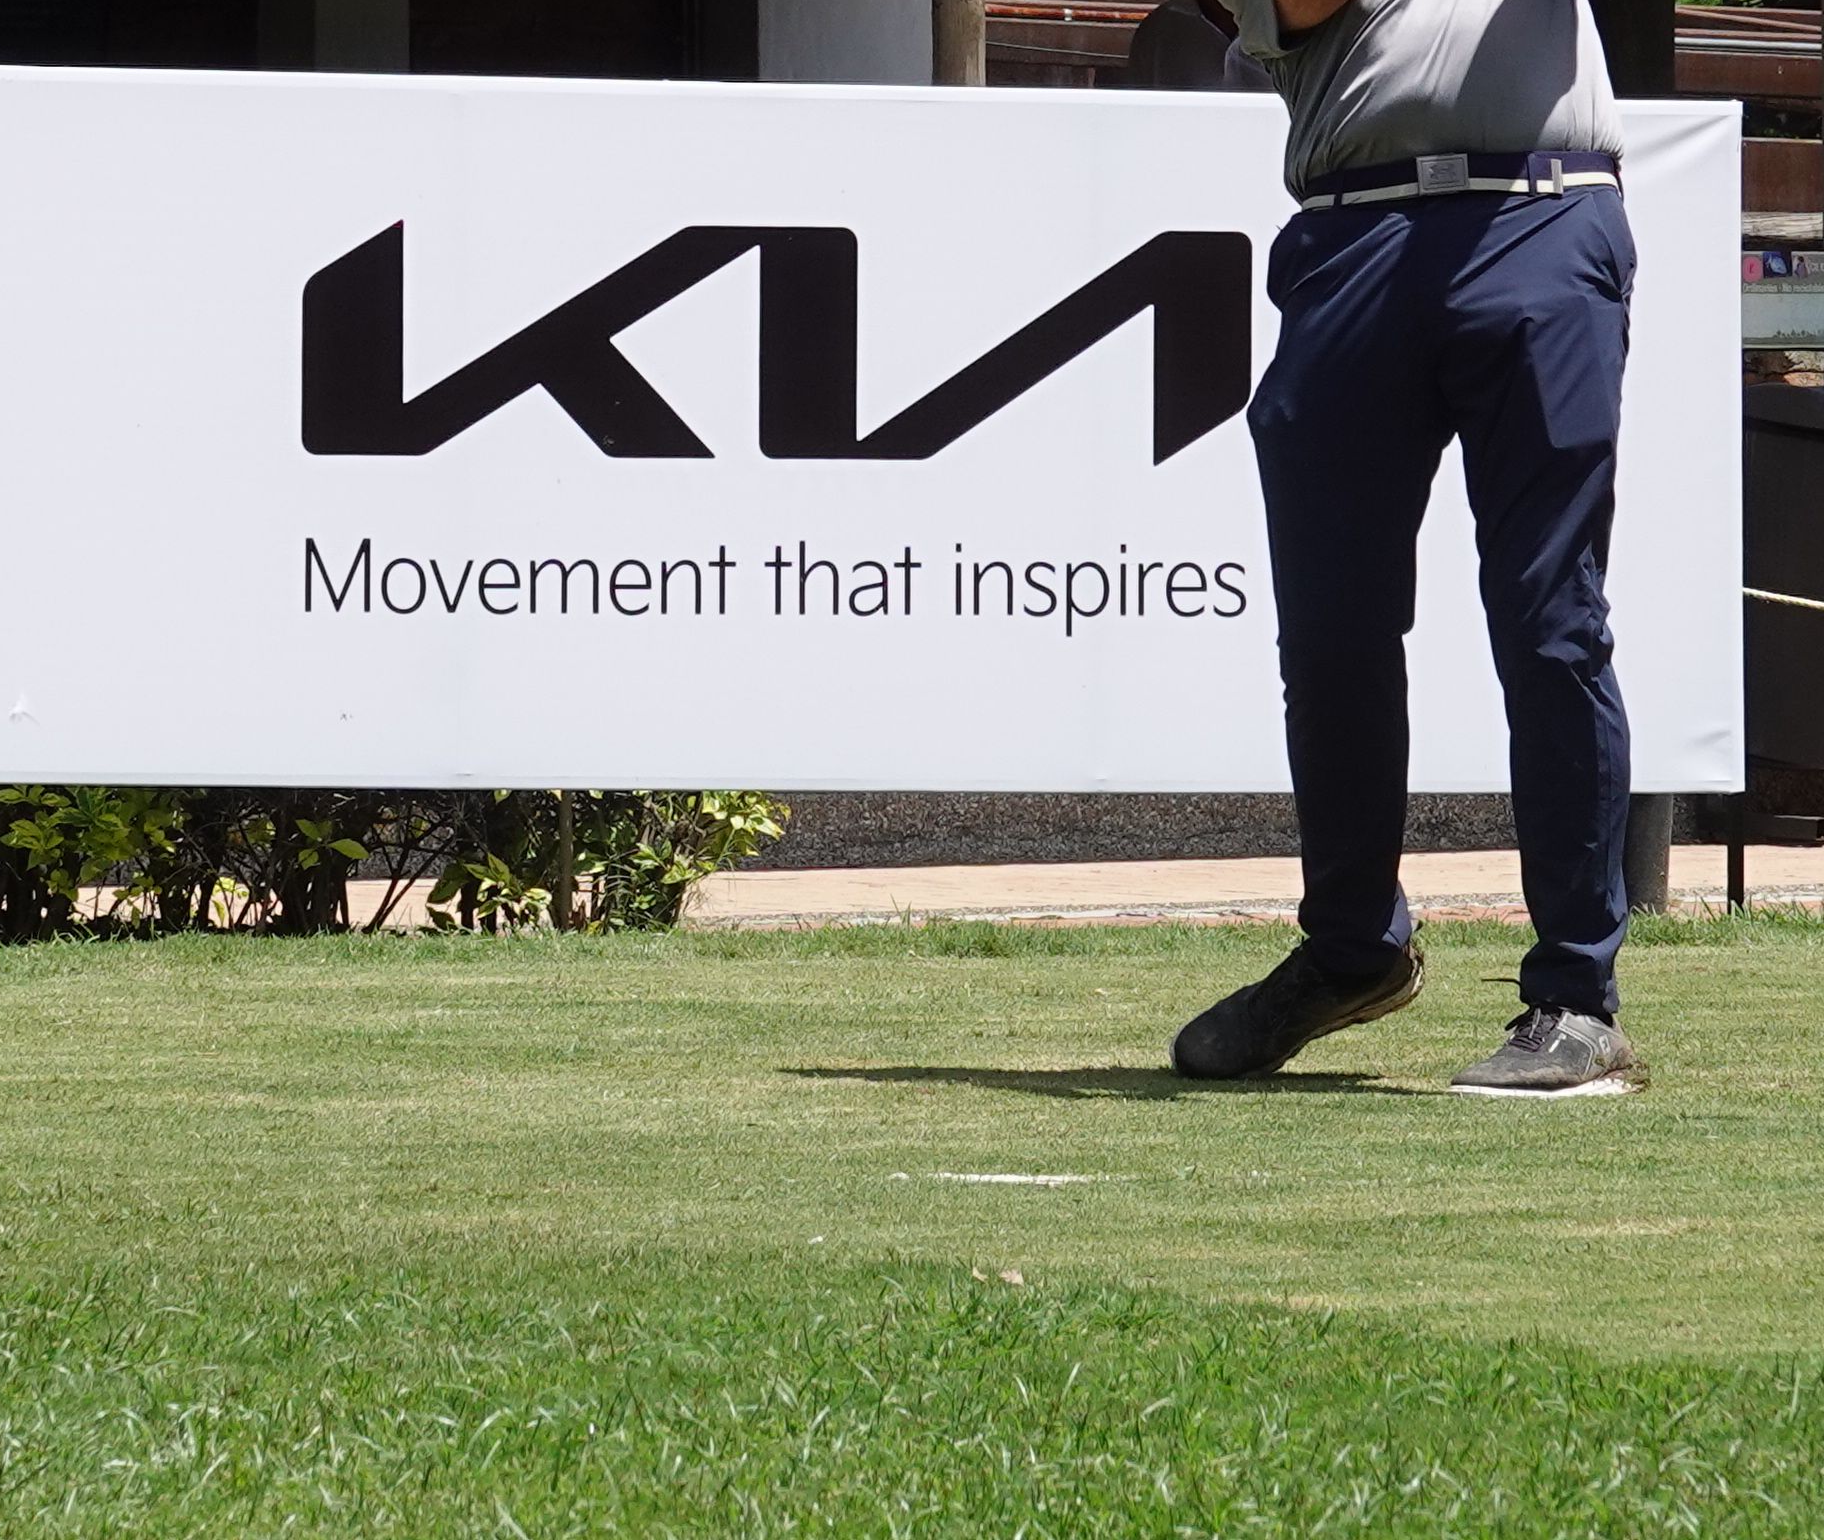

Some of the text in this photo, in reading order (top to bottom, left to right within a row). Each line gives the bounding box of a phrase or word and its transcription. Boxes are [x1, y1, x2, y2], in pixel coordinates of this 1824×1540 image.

[302, 220, 1252, 465] KIA
[305, 538, 1247, 636] Movement that inspires
